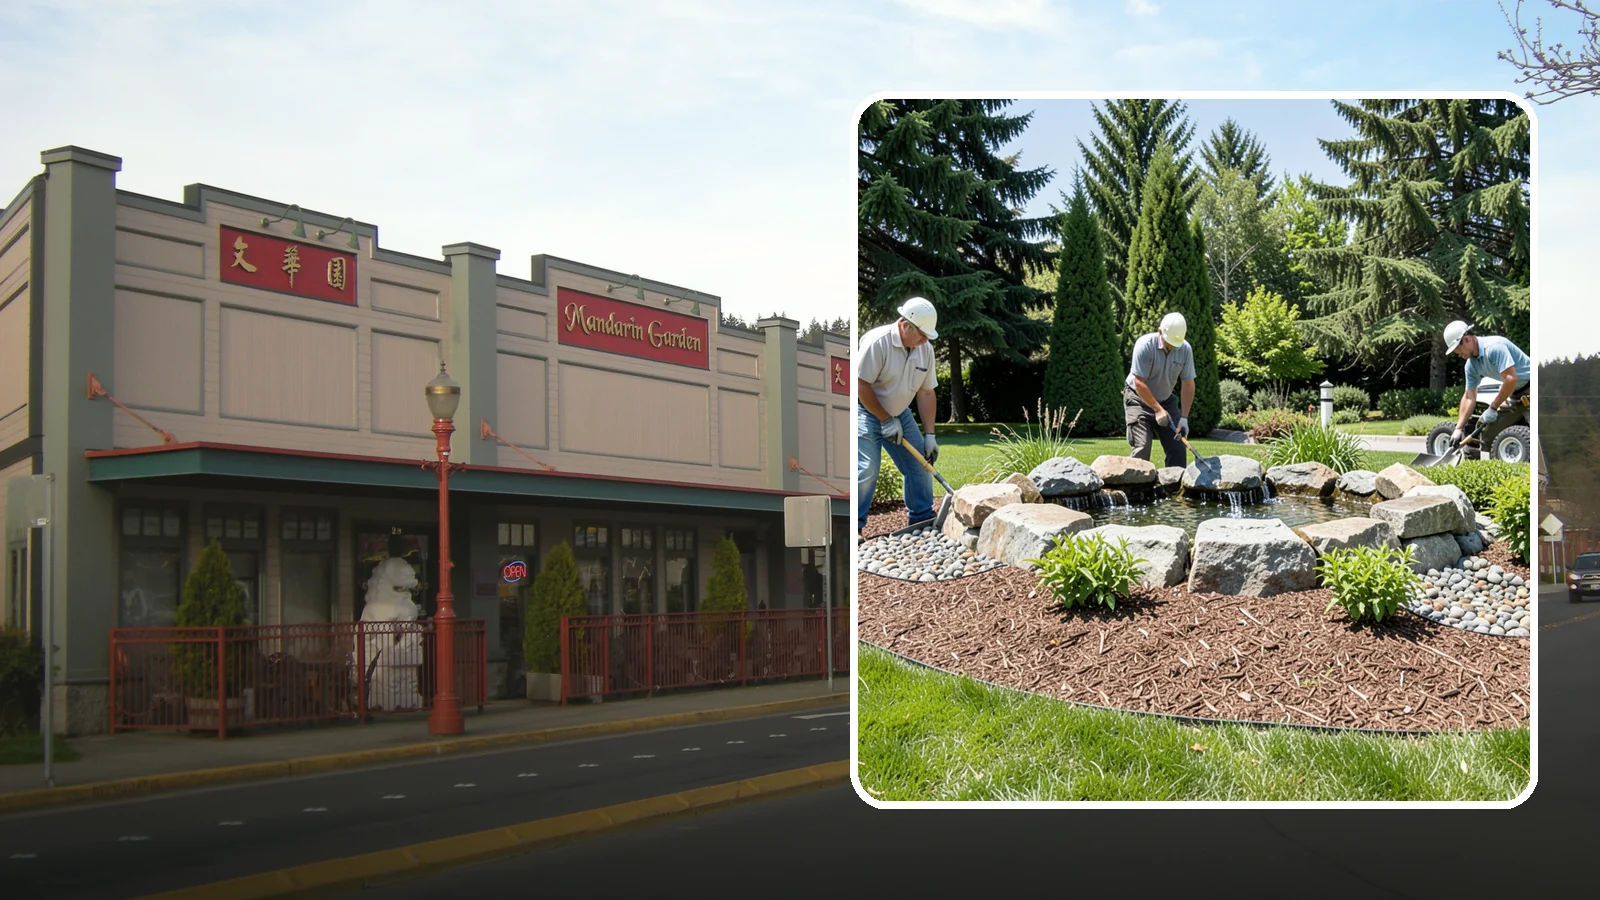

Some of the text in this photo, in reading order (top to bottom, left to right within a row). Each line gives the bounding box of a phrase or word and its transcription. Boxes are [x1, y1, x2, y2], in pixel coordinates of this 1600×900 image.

[231, 236, 346, 290] 文華園
[564, 302, 702, 352] Mandarin Garden
[503, 565, 527, 578] OPEN
